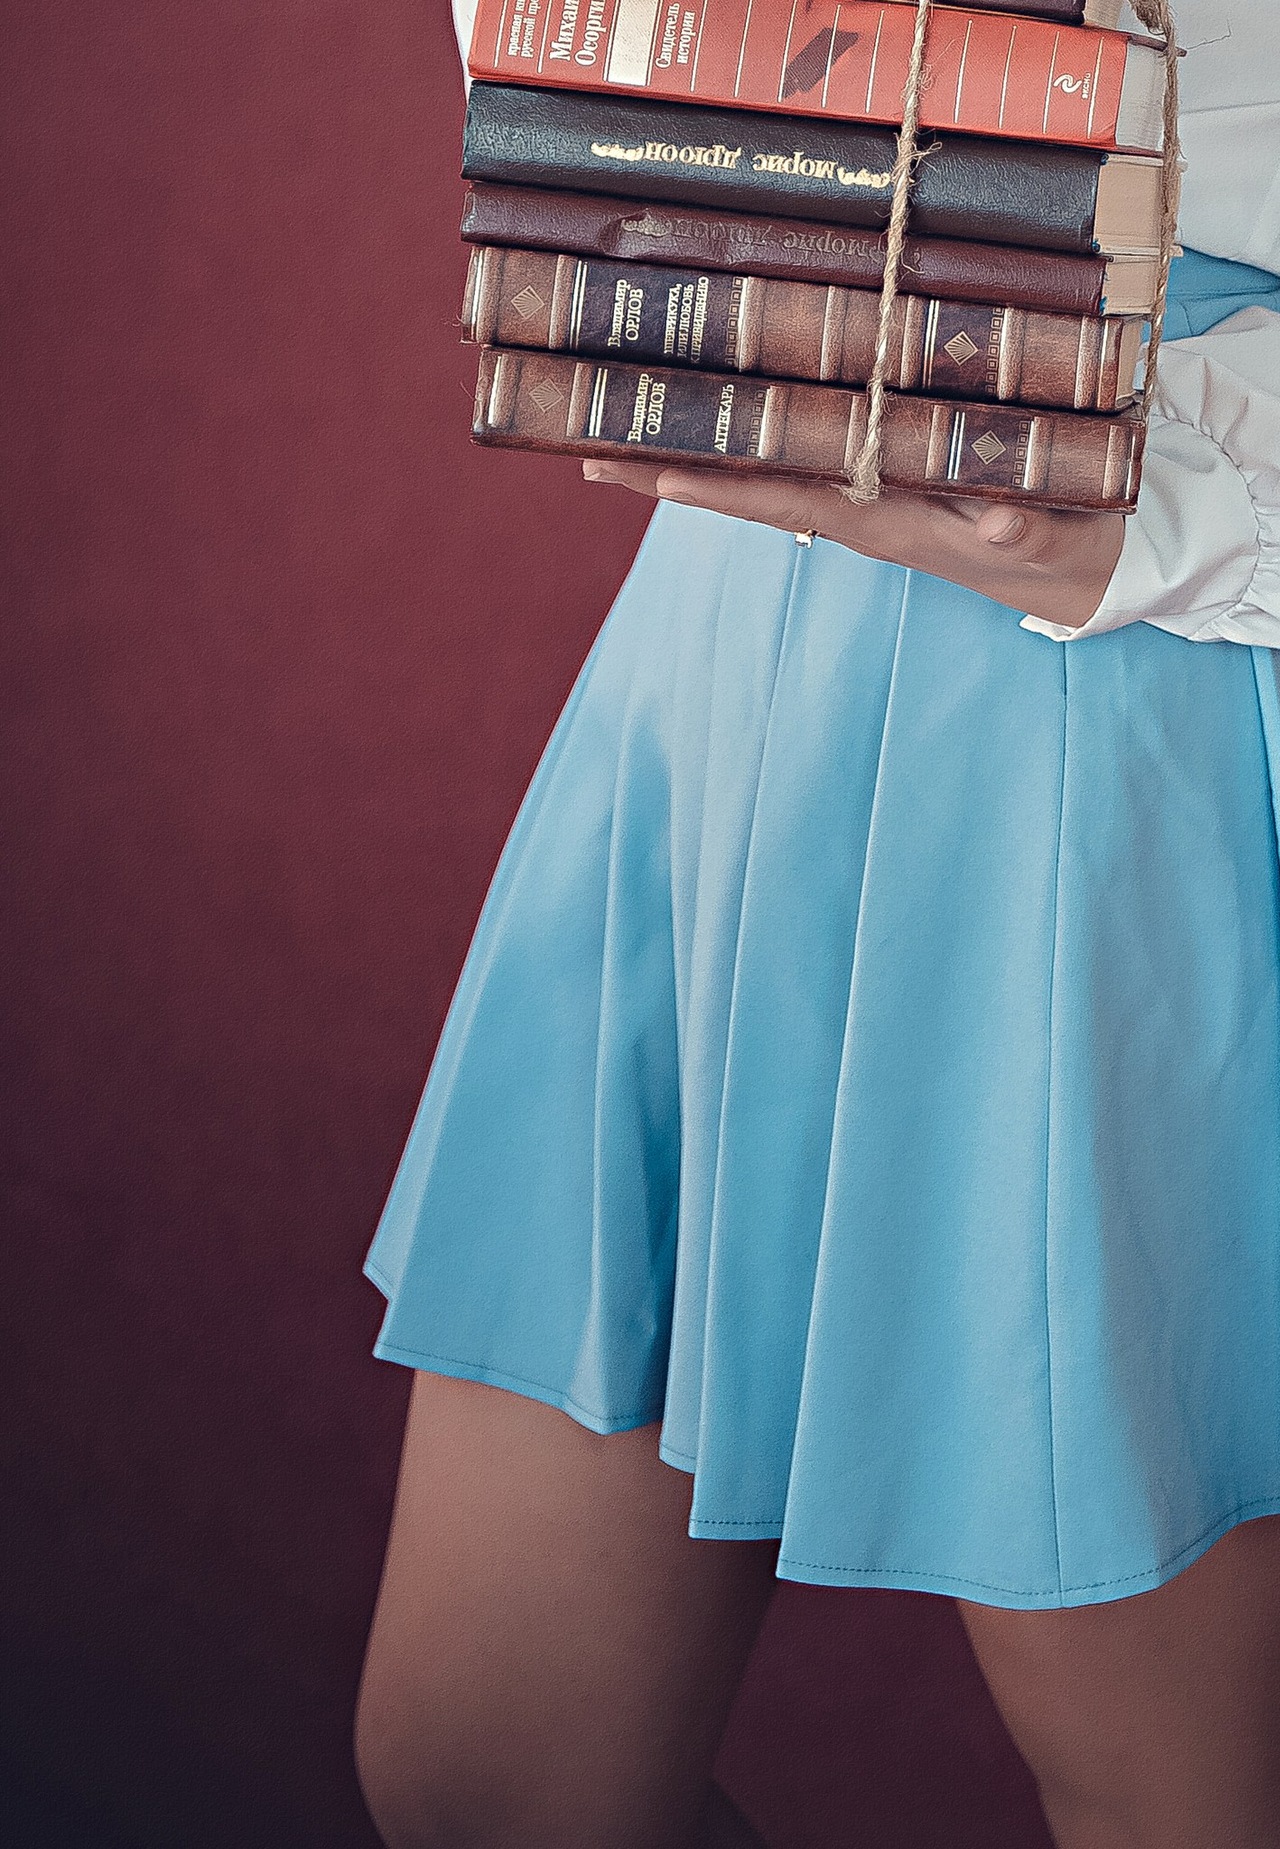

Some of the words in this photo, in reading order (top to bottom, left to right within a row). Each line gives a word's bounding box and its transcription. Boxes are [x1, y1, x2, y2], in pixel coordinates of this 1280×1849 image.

[507, 14, 524, 56] красная
[520, 18, 538, 58] русской
[655, 3, 681, 69] Свидетель
[676, 10, 696, 65] истории
[608, 279, 631, 347] Владимир
[625, 288, 644, 341] ОРЛОВ
[627, 373, 653, 442] Владимир
[646, 382, 666, 435] ОРЛОВ
[714, 384, 734, 453] АПТЕКАРЬ
